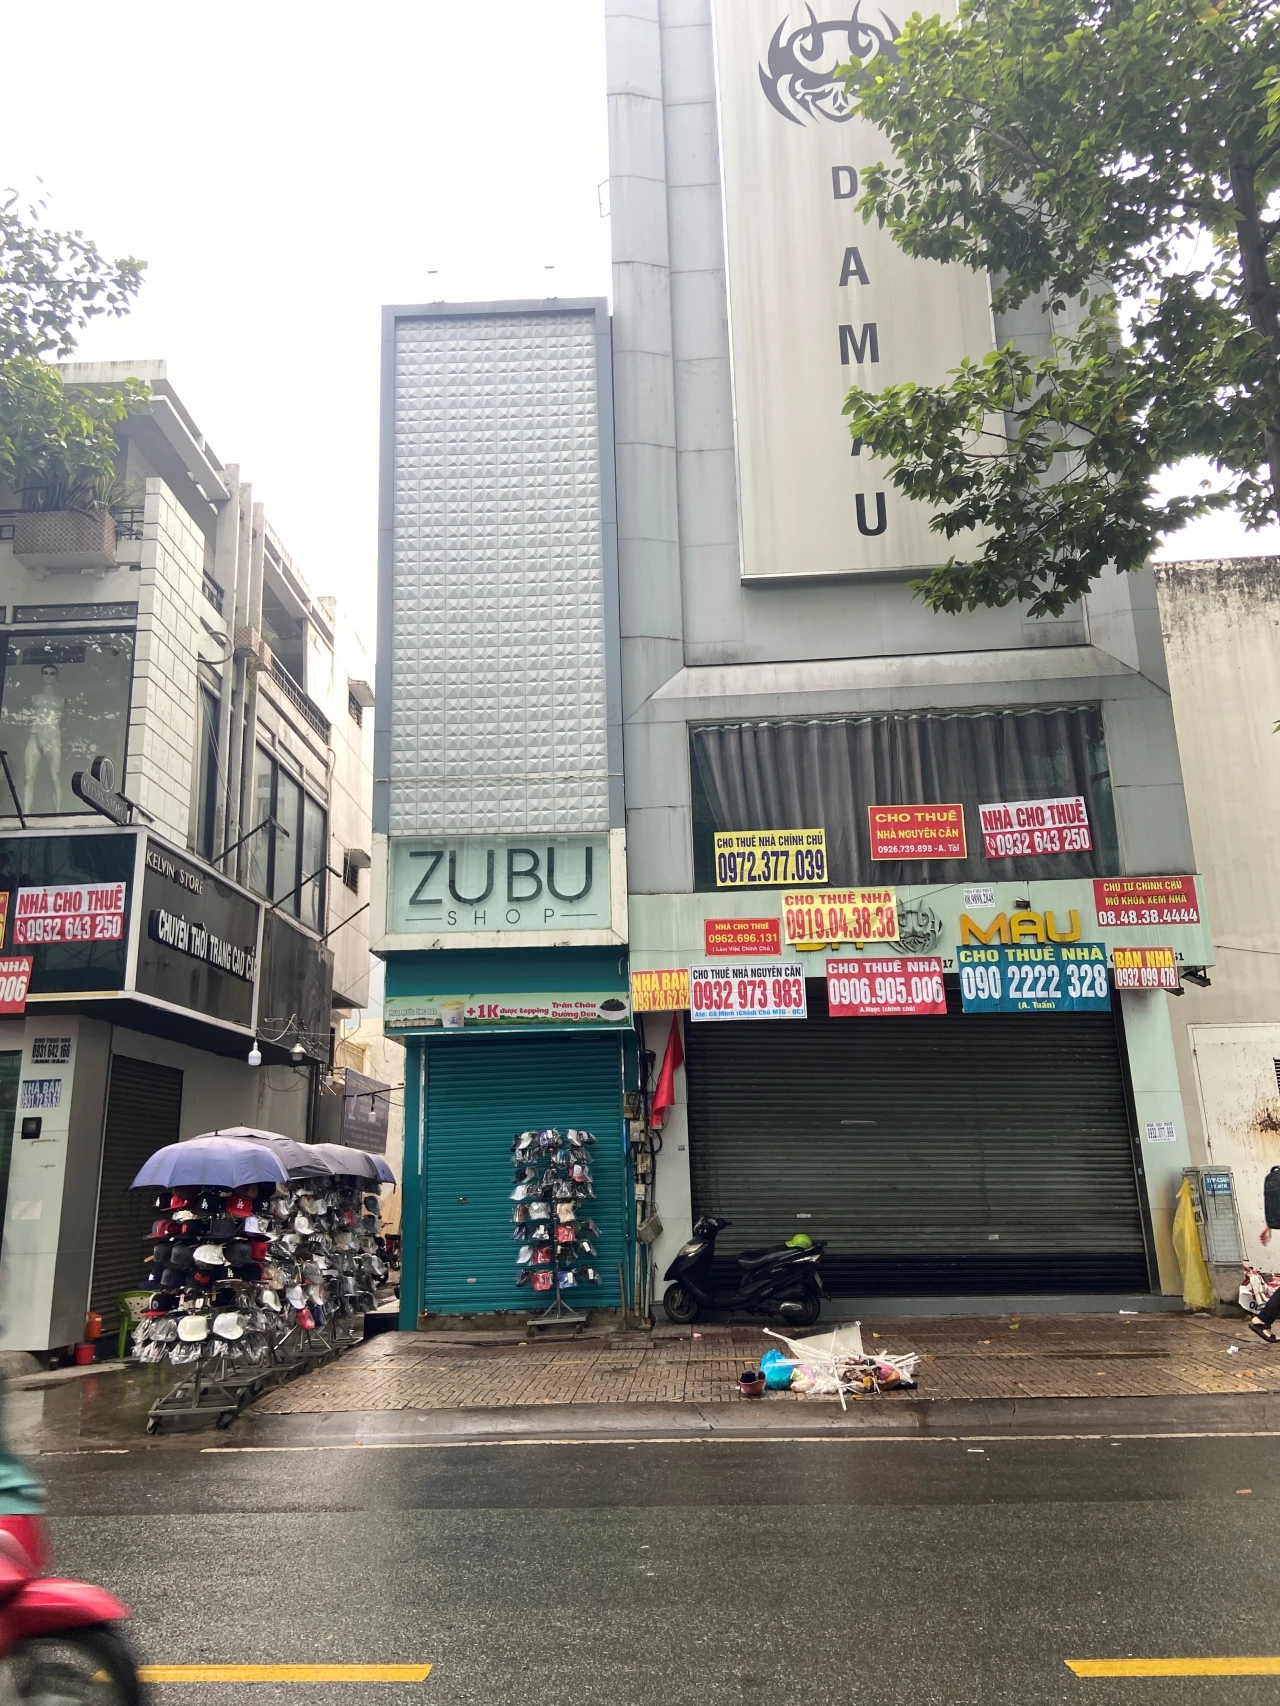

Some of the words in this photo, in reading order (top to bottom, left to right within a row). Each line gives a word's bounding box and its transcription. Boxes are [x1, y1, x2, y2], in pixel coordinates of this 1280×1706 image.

[875, 813, 911, 822] CHO
[914, 810, 958, 822] THUÊ
[982, 805, 1014, 830] NHÀ
[1016, 806, 1046, 828] CHO
[1048, 798, 1086, 825] THUÊ
[717, 838, 734, 848] CHO
[736, 835, 756, 848] THUÊ
[758, 834, 776, 847] NHÀ
[778, 833, 804, 846] CHÍNH
[806, 831, 823, 845] CHỦ
[877, 828, 897, 839] NHÀ
[898, 827, 936, 838] NGUYÊN
[938, 826, 959, 838] CĂN
[878, 844, 932, 854] 0926.739.898
[948, 844, 960, 852] Tài
[996, 832, 1032, 856] 0932
[1034, 830, 1060, 852] 643
[1063, 828, 1090, 850] 250
[146, 850, 175, 878] KELVIN
[179, 868, 204, 895] STORE
[718, 849, 825, 884] 0972.377.039
[1122, 882, 1134, 891] TƯ
[1136, 879, 1163, 890] CHÍNH
[1164, 878, 1183, 890] CHỦ
[18, 888, 48, 915] NHÀ
[53, 890, 83, 913] CHO
[87, 884, 123, 911] THUÊ
[784, 894, 815, 906] CHO
[818, 890, 856, 904] THUÊ
[861, 890, 892, 903] NHÀ
[1105, 896, 1119, 906] MỞ
[1147, 895, 1166, 904] XEM
[1168, 892, 1188, 904] NHÀ
[447, 908, 555, 926] SHOP
[786, 906, 896, 940] 0919.04.38.38
[1098, 908, 1198, 924] 08.48.38.4444
[26, 918, 62, 942] 0932
[64, 916, 91, 940] 643
[95, 914, 122, 939] 250
[715, 922, 732, 931] NHÀ
[733, 922, 750, 930] CHO
[752, 922, 770, 930] THUÊ
[958, 909, 1082, 946] MAU
[158, 908, 190, 952] CHUYÊN
[191, 922, 208, 960] THỜI
[210, 934, 232, 970] TRANG
[232, 948, 245, 976] CAO
[708, 934, 778, 944] 0962.696.131
[960, 950, 1000, 963] CHO
[1004, 946, 1056, 962] THUÊ
[1061, 945, 1104, 960] NHÀ
[1115, 948, 1142, 968] BÁN
[1145, 948, 1174, 968] NHÀ
[692, 970, 708, 980] CHO
[710, 966, 730, 978] THUÊ
[732, 966, 748, 978] NHÀ
[751, 965, 782, 978] NGUYÊN
[784, 965, 801, 977] CĂN
[828, 962, 859, 974] CHO
[863, 960, 902, 974] THUÊ
[907, 958, 941, 972] NHÀ
[942, 960, 954, 968] 17
[632, 970, 660, 991] NHÀ
[662, 970, 688, 990] BÁN
[961, 966, 1002, 1000] 090
[1008, 964, 1062, 999] 2222
[1066, 964, 1108, 998] 328
[1117, 968, 1139, 986] 0932
[1142, 968, 1158, 986] 099
[1160, 968, 1176, 986] 478
[693, 980, 734, 1010] 0932
[738, 980, 768, 1009] 973
[772, 978, 802, 1008] 983
[829, 976, 944, 1005] 0906.905.006
[633, 990, 690, 1010] 0931.28.62.62
[1018, 1002, 1031, 1010] (A.
[1032, 1000, 1056, 1010] Tuấn)
[520, 1006, 549, 1015] topping
[32, 1044, 47, 1058] 0931
[48, 1044, 59, 1058] 642
[23, 1079, 40, 1094] NHÀ
[42, 1078, 61, 1094] BÁN
